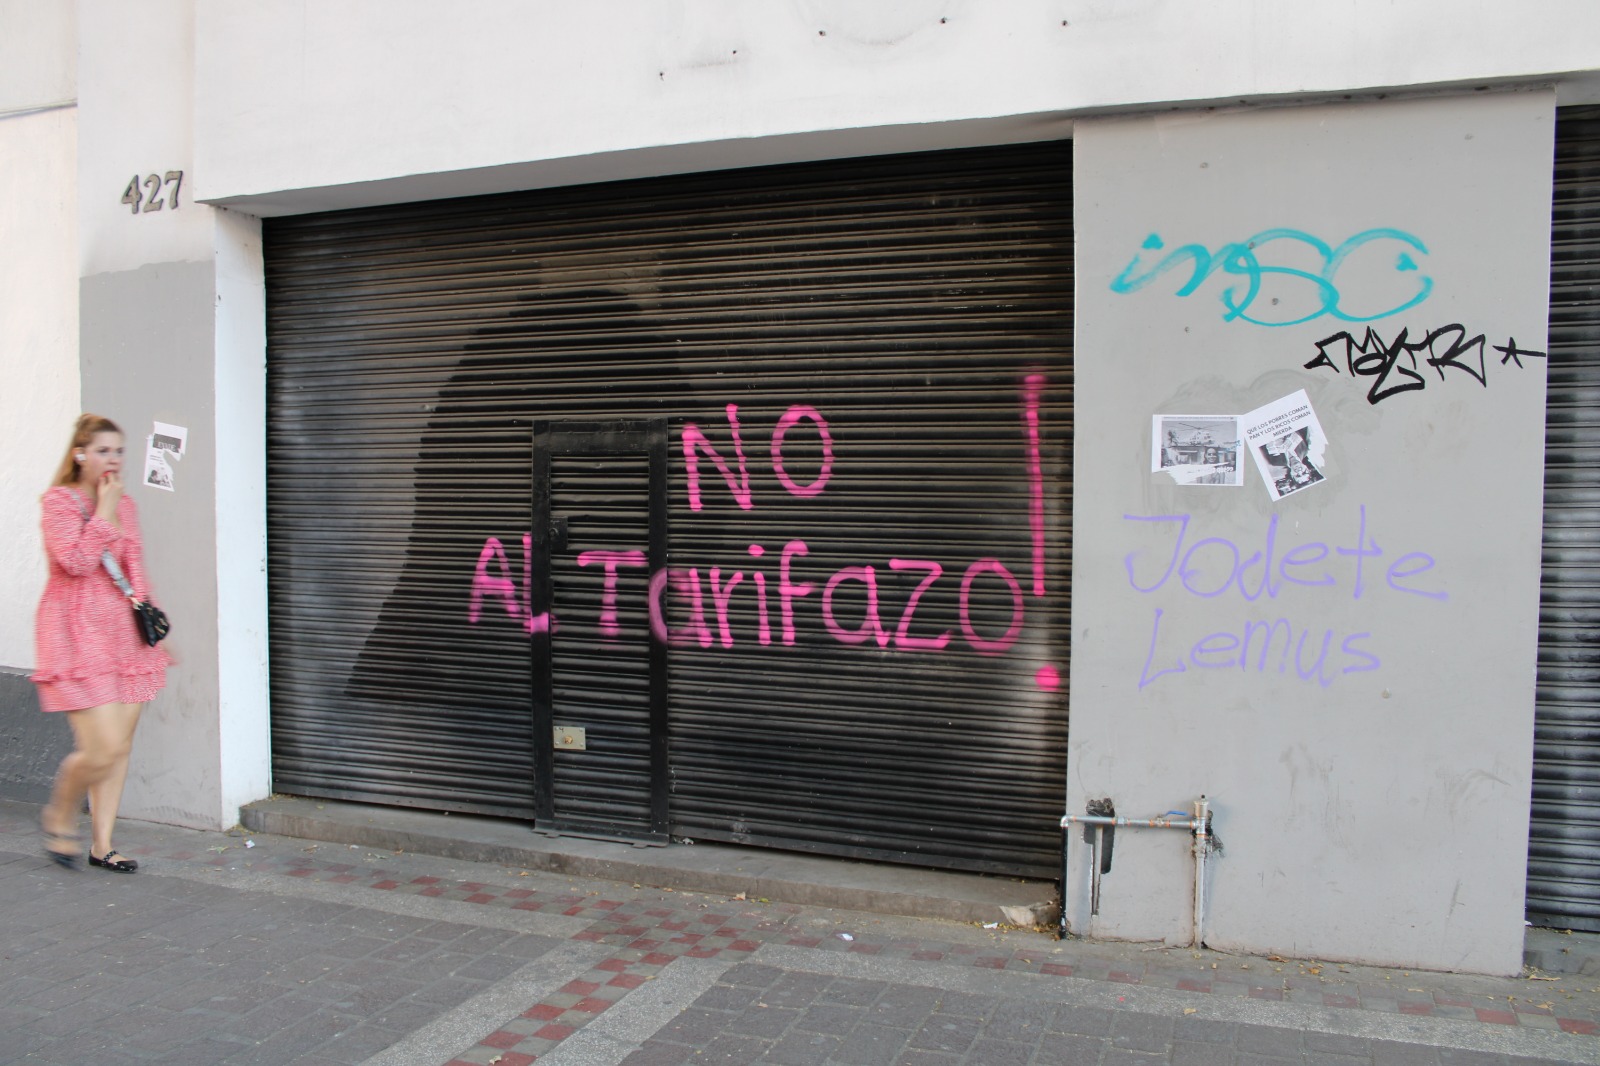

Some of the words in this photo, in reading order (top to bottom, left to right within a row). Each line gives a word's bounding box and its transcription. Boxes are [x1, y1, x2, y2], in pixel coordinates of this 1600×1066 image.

[121, 171, 184, 215] 427
[1249, 432, 1261, 440] PAN
[1274, 419, 1291, 429] RICOS
[1290, 410, 1311, 422] COMAN
[1267, 413, 1289, 425] POBRES
[1288, 404, 1308, 416] COMAN
[1272, 426, 1292, 437] MIERDA
[682, 403, 834, 512] NO
[1138, 607, 1382, 691] Lemus
